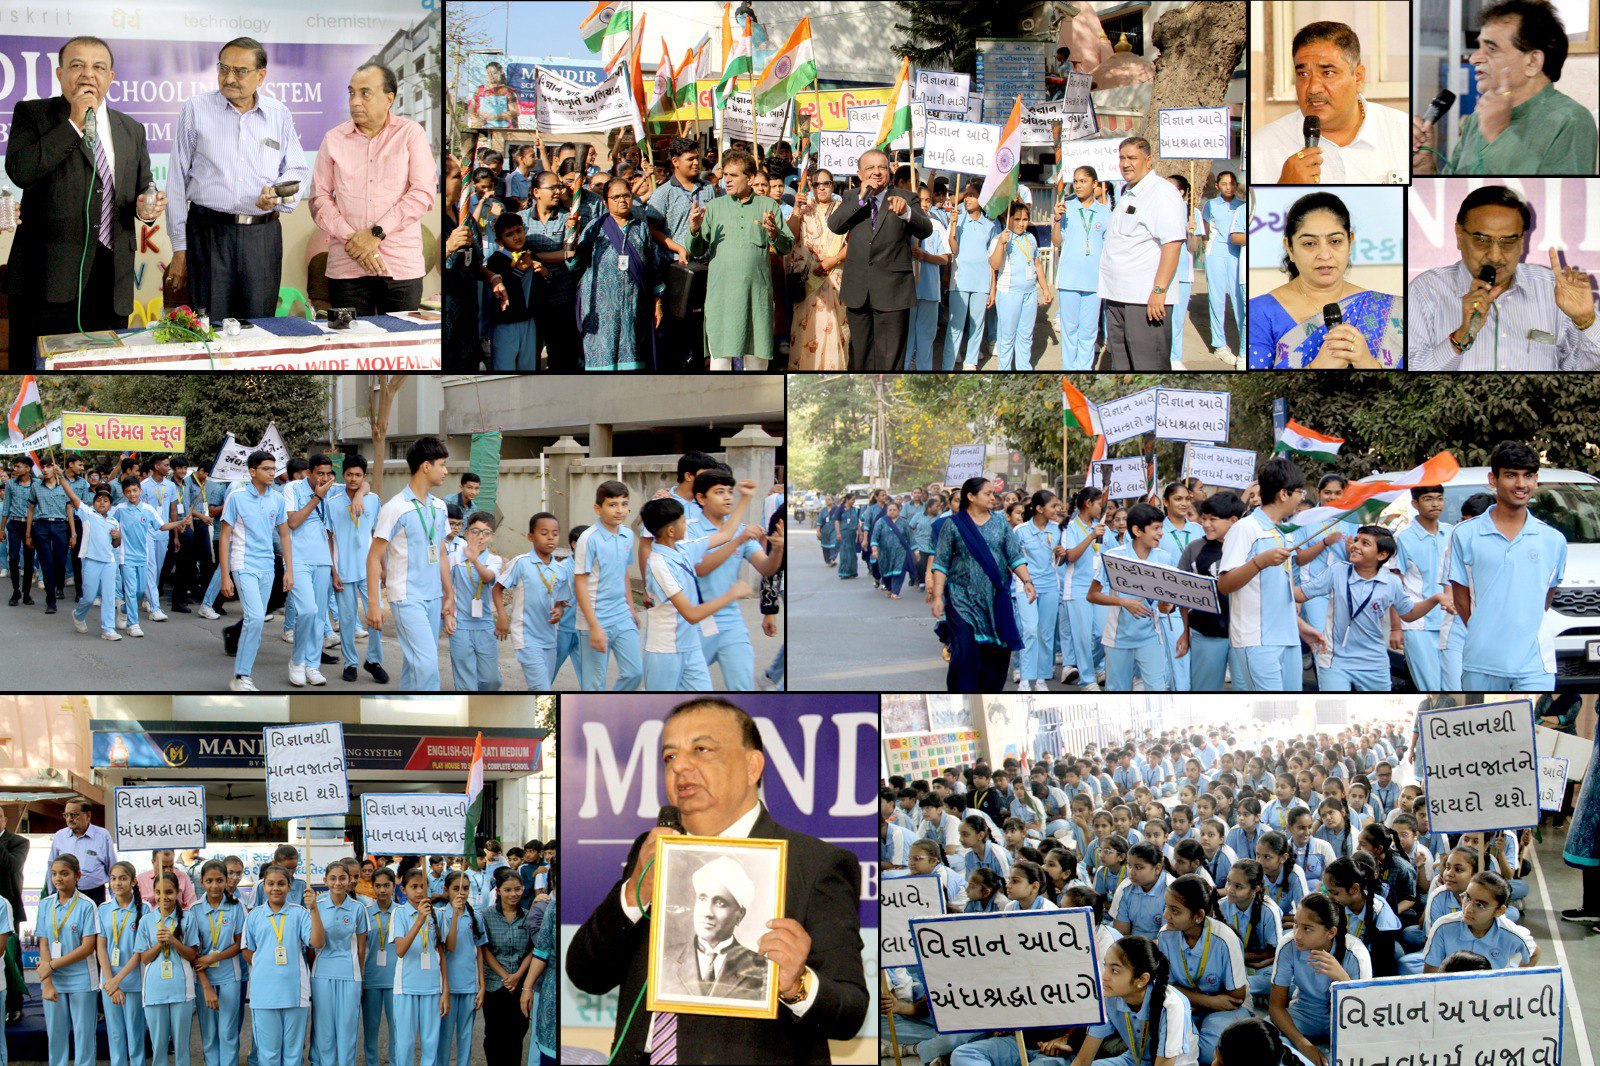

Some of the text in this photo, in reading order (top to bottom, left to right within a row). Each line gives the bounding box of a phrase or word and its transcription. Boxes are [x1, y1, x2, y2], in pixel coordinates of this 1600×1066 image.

[184, 14, 272, 33] technology
[306, 13, 388, 31] chemistry
[1160, 112, 1195, 126] વિજ્ઞાન
[926, 121, 960, 138] વિજ્ઞાન
[1157, 392, 1195, 409] વિજ્ઞાન
[66, 422, 89, 447] ન્યુ
[94, 417, 145, 441] પરિમલ
[1115, 576, 1146, 592] દિન
[1430, 710, 1516, 740] વિજ્ઞાનથી
[271, 728, 331, 748] વિજ્ઞાનથી
[363, 748, 403, 758] SYSTEM
[500, 746, 530, 757] MEDIUM
[268, 756, 345, 777] માનવજાતને
[1426, 750, 1535, 780] માનવજાતને
[117, 791, 164, 808] વિજ્ઞાન
[270, 785, 309, 805] ફાયદો
[1430, 787, 1533, 817] ફાયદો થશે.
[365, 798, 467, 817] વિજ્ઞાન અપનાવી
[118, 821, 174, 838] અંધશ્રદ્ધા
[365, 827, 428, 843] માનવધર્મ
[917, 921, 1091, 959] વિજ્ઞાન આવે,
[930, 973, 1098, 1009] અંધશ્રદ્ધા ભાગે
[1339, 984, 1557, 1030] વિજ્ઞાન અપનાવી
